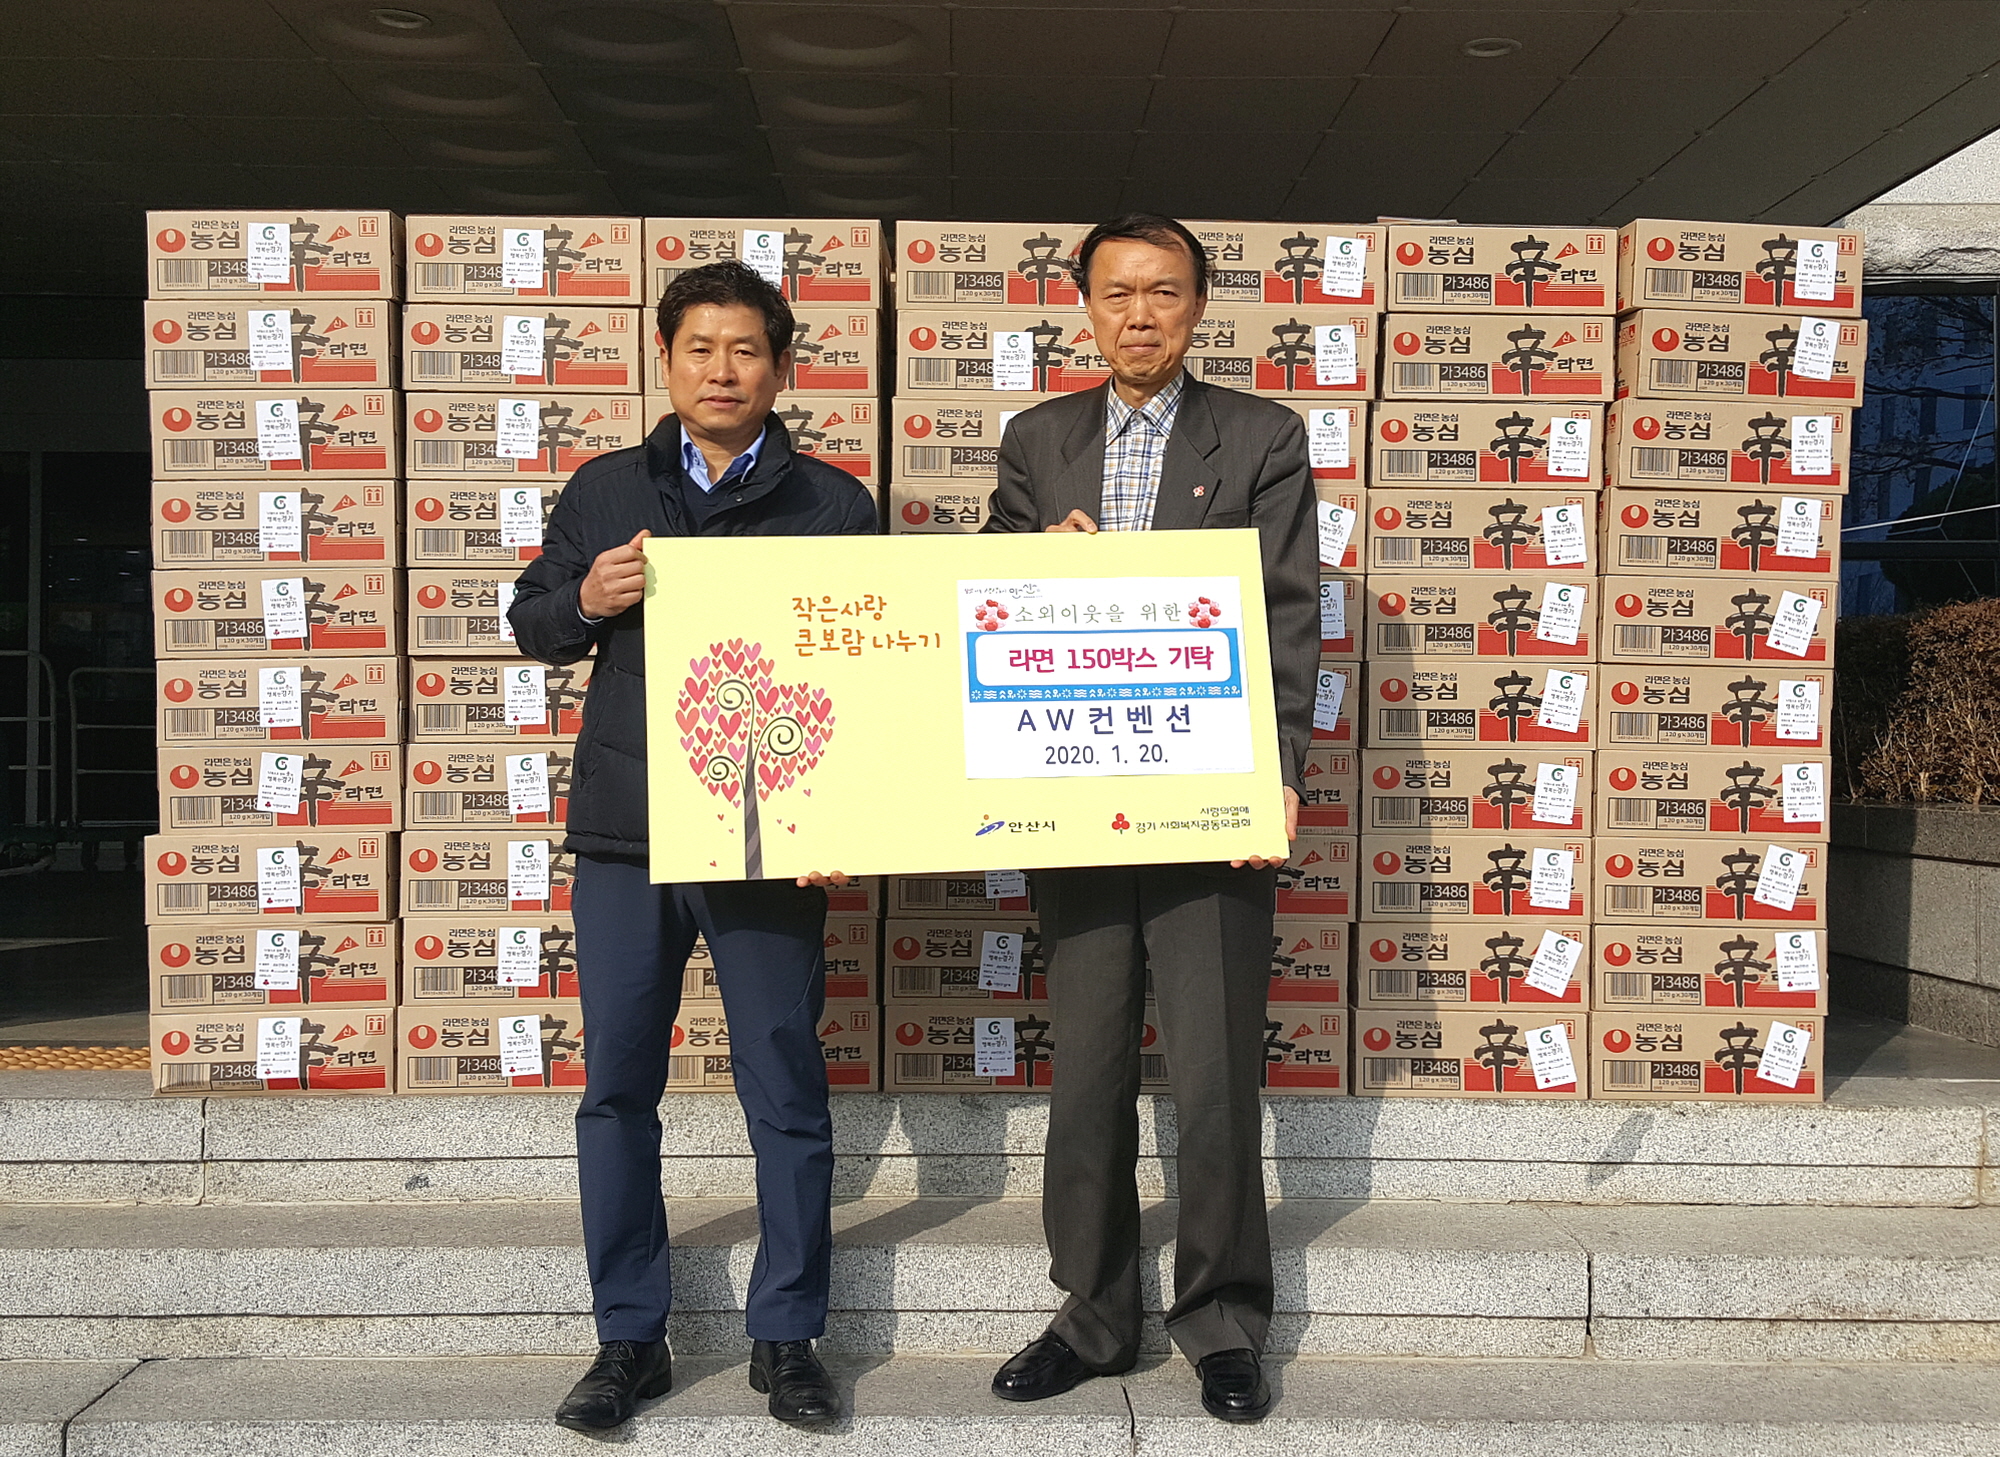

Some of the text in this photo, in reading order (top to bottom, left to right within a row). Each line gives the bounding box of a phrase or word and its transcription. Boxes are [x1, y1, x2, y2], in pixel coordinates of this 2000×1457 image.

[192, 220, 238, 230] 라면은 농심
[191, 230, 239, 250] 농심
[690, 230, 735, 239] 라면은 농심
[830, 239, 838, 247] 신
[1680, 232, 1724, 241] 라면은 농심
[448, 235, 495, 254] 농심
[689, 240, 735, 260] 농심
[940, 244, 985, 262] 농심
[1566, 246, 1573, 254] 신
[1679, 242, 1724, 261] 농심
[332, 251, 371, 267] 라면
[1428, 246, 1473, 265] 농심
[585, 258, 622, 273] 라면
[825, 262, 862, 278] 라면
[1017, 232, 1075, 307] 辛
[1275, 232, 1331, 305] 辛
[1505, 235, 1562, 308] 辛
[957, 274, 1001, 288] 가3486
[1445, 276, 1489, 290] 가3486
[1560, 269, 1597, 284] 라면
[187, 321, 235, 341] 농심
[334, 320, 342, 328] 신
[942, 321, 986, 330] 라면은 농심
[1426, 326, 1470, 334] 라면은 농심
[445, 324, 492, 343] 농심
[941, 331, 986, 350] 농심
[1683, 333, 1729, 352] 농심
[329, 342, 368, 358] 라면
[582, 346, 620, 362] 라면
[1424, 336, 1470, 354] 농심
[823, 351, 860, 366] 라면
[1266, 318, 1323, 392] 辛
[1502, 324, 1558, 397] 辛
[1205, 360, 1250, 373] 가3486
[1557, 357, 1594, 372] 라면
[1699, 364, 1743, 377] 가3486
[449, 403, 494, 412] 라면은 농심
[196, 410, 244, 430] 농심
[448, 413, 495, 432] 농심
[936, 419, 981, 438] 농심
[339, 430, 376, 446] 라면
[1412, 423, 1458, 442] 농심
[1664, 421, 1710, 440] 농심
[586, 434, 622, 450] 라면
[826, 438, 863, 453] 라면
[1490, 411, 1547, 484] 辛
[1742, 412, 1798, 485] 辛
[1430, 452, 1474, 466] 가3486
[196, 501, 244, 521] 농심
[449, 501, 496, 520] 농심
[1654, 499, 1699, 508] 라면은 농심
[934, 505, 979, 524] 농심
[1406, 510, 1451, 529] 농심
[1654, 509, 1699, 528] 농심
[337, 521, 375, 537] 라면
[1484, 498, 1540, 571] 辛
[1669, 539, 1715, 553] 가3486
[198, 580, 245, 590] 라면은 농심
[198, 590, 246, 610] 농심
[451, 588, 498, 608] 농심
[1410, 596, 1455, 615] 농심
[1014, 602, 1182, 624] 소외이웃을 위한
[1647, 598, 1693, 617] 농심
[339, 610, 377, 626] 라면
[1488, 584, 1544, 657] 辛
[217, 621, 263, 634] 가3486
[1427, 626, 1471, 639] 가3486
[795, 628, 940, 657] 큰보람 나누기
[1009, 646, 1214, 673] 라면 150박스 기탁
[344, 676, 352, 685] 신
[1412, 672, 1456, 681] 라면은 농심
[199, 679, 245, 699] 농심
[450, 676, 497, 696] 농심
[1412, 682, 1457, 700] 농심
[1644, 686, 1689, 704] 농심
[339, 699, 377, 714] 라면
[1722, 675, 1778, 748] 辛
[1660, 716, 1705, 729] 가3486
[1045, 744, 1168, 765] 2020. 1. 20.
[204, 767, 251, 787] 농심
[447, 764, 494, 783] 농심
[1404, 770, 1450, 788] 농심
[1642, 771, 1687, 790] 농심
[345, 786, 383, 802] 라면
[1306, 788, 1341, 804] 라면
[1721, 761, 1777, 834] 辛
[1422, 799, 1466, 813] 가3486
[1008, 820, 1056, 833] 안산시
[444, 842, 490, 851] 라면은 농심
[191, 854, 239, 874] 농심
[443, 852, 490, 871] 농심
[1309, 854, 1317, 862] 신
[1405, 855, 1450, 874] 농심
[1638, 858, 1683, 877] 농심
[332, 873, 370, 889] 라면
[460, 881, 506, 895] 가3486
[1304, 875, 1340, 891] 라면
[210, 884, 257, 899] 가3486
[1655, 888, 1699, 902] 가3486
[448, 938, 495, 958] 농심
[926, 939, 971, 958] 농심
[1637, 935, 1681, 944] 라면은 농심
[196, 945, 244, 965] 농심
[1402, 942, 1447, 961] 농심
[1636, 945, 1681, 964] 농심
[339, 962, 377, 978] 라면
[825, 958, 860, 974] 라면
[1294, 963, 1331, 979] 라면
[1480, 931, 1537, 1004] 辛
[1714, 934, 1772, 1009] 辛
[1419, 972, 1464, 986] 가3486
[195, 1033, 243, 1053] 농심
[441, 1028, 488, 1047] 농심
[928, 1026, 973, 1045] 농심
[1396, 1030, 1441, 1049] 농심
[1635, 1033, 1682, 1052] 농심
[338, 1051, 375, 1066] 라면
[824, 1046, 861, 1062] 라면
[1294, 1048, 1332, 1064] 라면
[1653, 1063, 1698, 1077] 가3486
